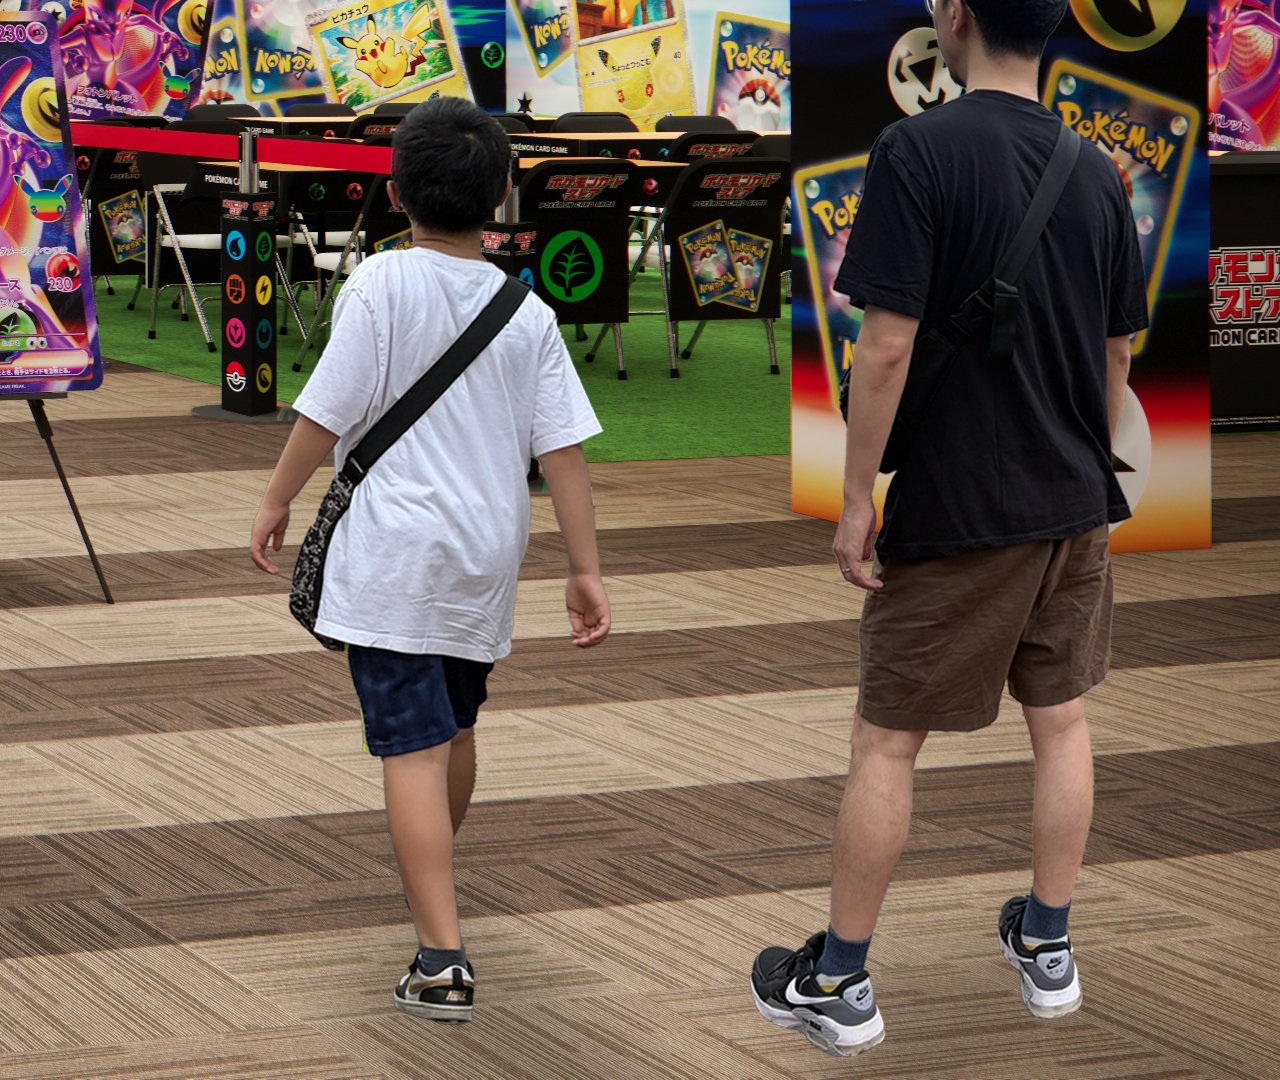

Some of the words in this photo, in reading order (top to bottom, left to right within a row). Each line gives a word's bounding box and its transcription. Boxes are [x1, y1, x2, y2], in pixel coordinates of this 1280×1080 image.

[551, 146, 568, 154] GAME
[546, 174, 628, 190] ポケモンカード
[700, 173, 780, 189] ポケモンカード
[563, 187, 600, 201] ストア
[716, 186, 753, 200] ストア
[48, 277, 73, 291] 230
